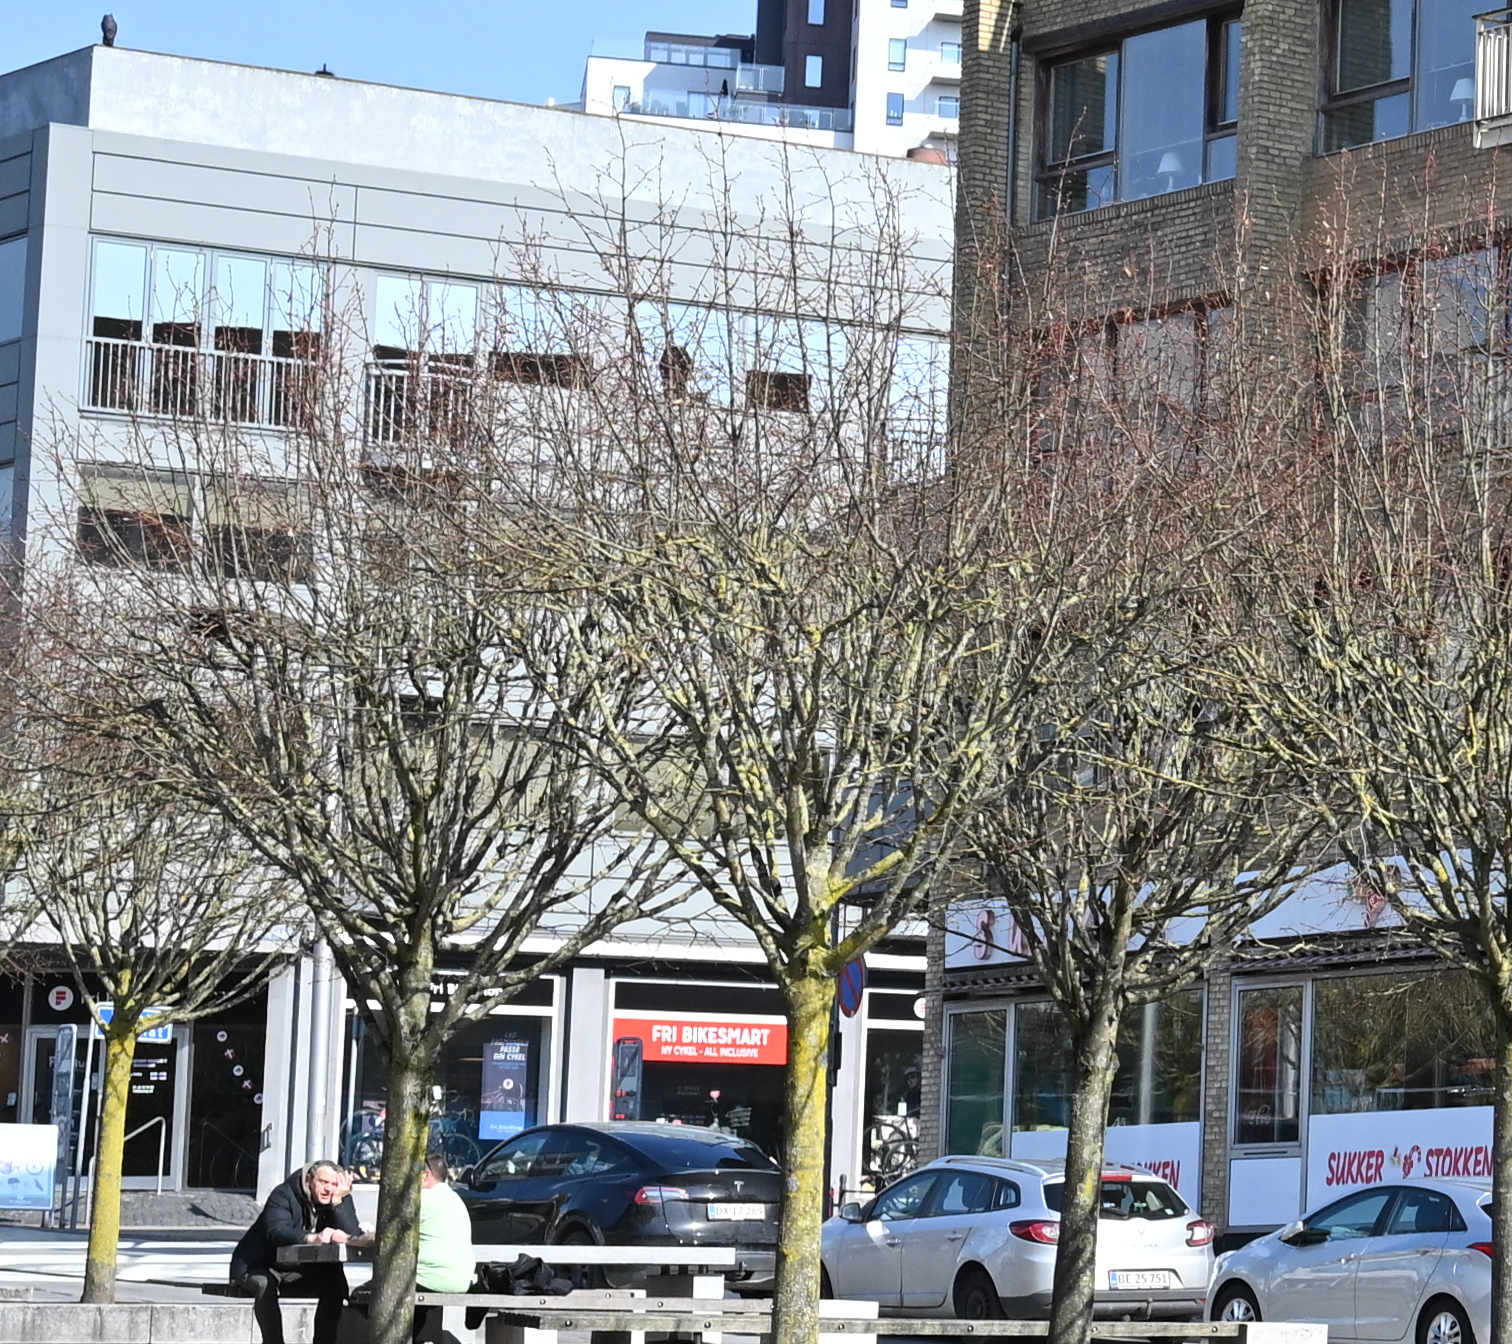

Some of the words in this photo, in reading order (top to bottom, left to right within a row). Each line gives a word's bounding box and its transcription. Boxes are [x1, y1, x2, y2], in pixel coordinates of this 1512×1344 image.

[651, 1025, 677, 1043] FRI
[681, 1025, 770, 1046] BIKESMART
[661, 1045, 673, 1055] NY
[673, 1045, 698, 1057] CYKEL
[704, 1046, 718, 1057] ALL
[720, 1047, 758, 1058] INCLUSIVE
[1325, 1149, 1385, 1187] SUKKER
[1424, 1145, 1494, 1177] STOKKEN
